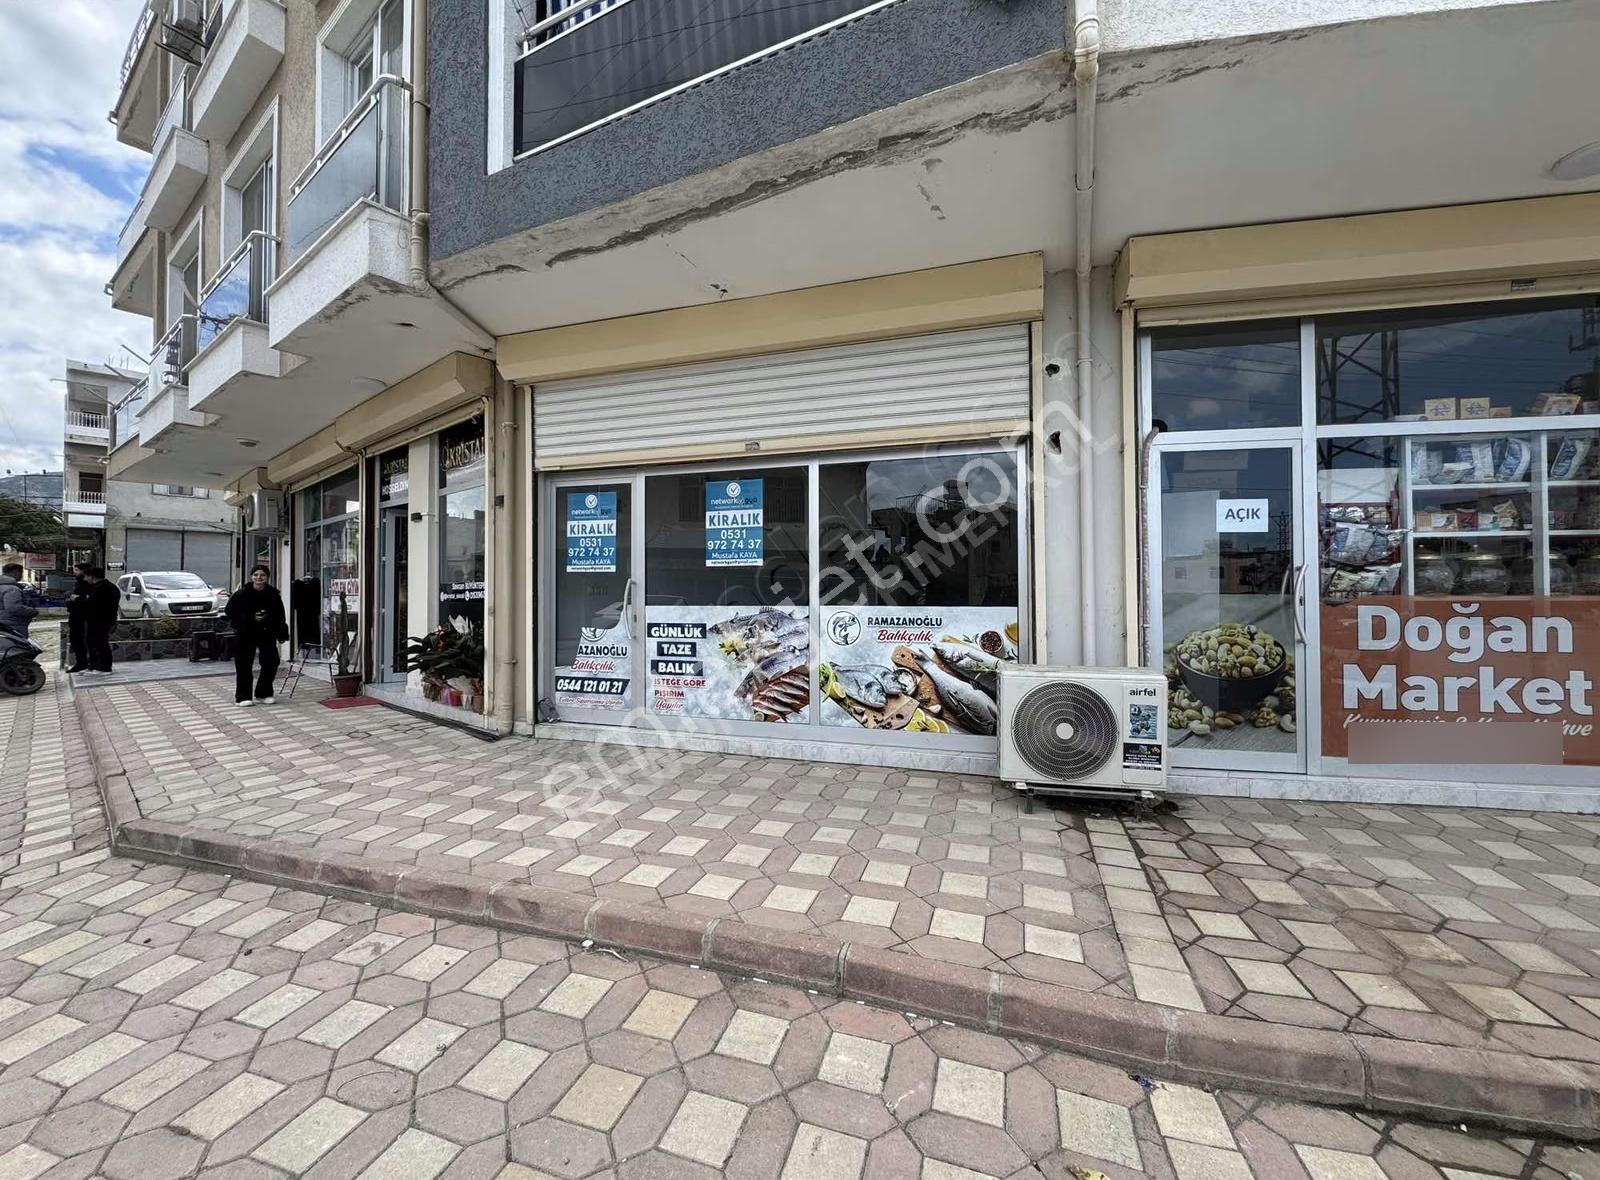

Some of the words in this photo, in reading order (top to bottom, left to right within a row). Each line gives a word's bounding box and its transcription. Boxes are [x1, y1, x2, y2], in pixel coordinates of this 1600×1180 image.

[709, 511, 760, 527] KİRALIK
[1225, 508, 1260, 522] AÇIK
[569, 521, 614, 535] KİRALIK
[721, 529, 746, 539] 0531
[580, 538, 602, 547] 0531
[707, 540, 727, 550] 972
[731, 540, 744, 549] 74
[748, 539, 761, 549] 37
[568, 548, 585, 557] 972
[588, 548, 600, 556] 74
[603, 547, 615, 556] 37
[711, 551, 738, 559] Mustafa
[867, 616, 943, 627] RAMAZANOĞLU
[651, 624, 702, 638] GÜNLÜK
[877, 629, 934, 644] Balıkçılık
[1357, 601, 1574, 663] Doğan
[662, 643, 692, 655] TAZE
[658, 662, 695, 674] BALIK
[557, 679, 582, 691] 0544
[583, 680, 598, 692] 121
[599, 680, 611, 692] 01
[611, 681, 623, 693] 21
[1129, 687, 1157, 697] airfel
[1343, 664, 1593, 715] Market
